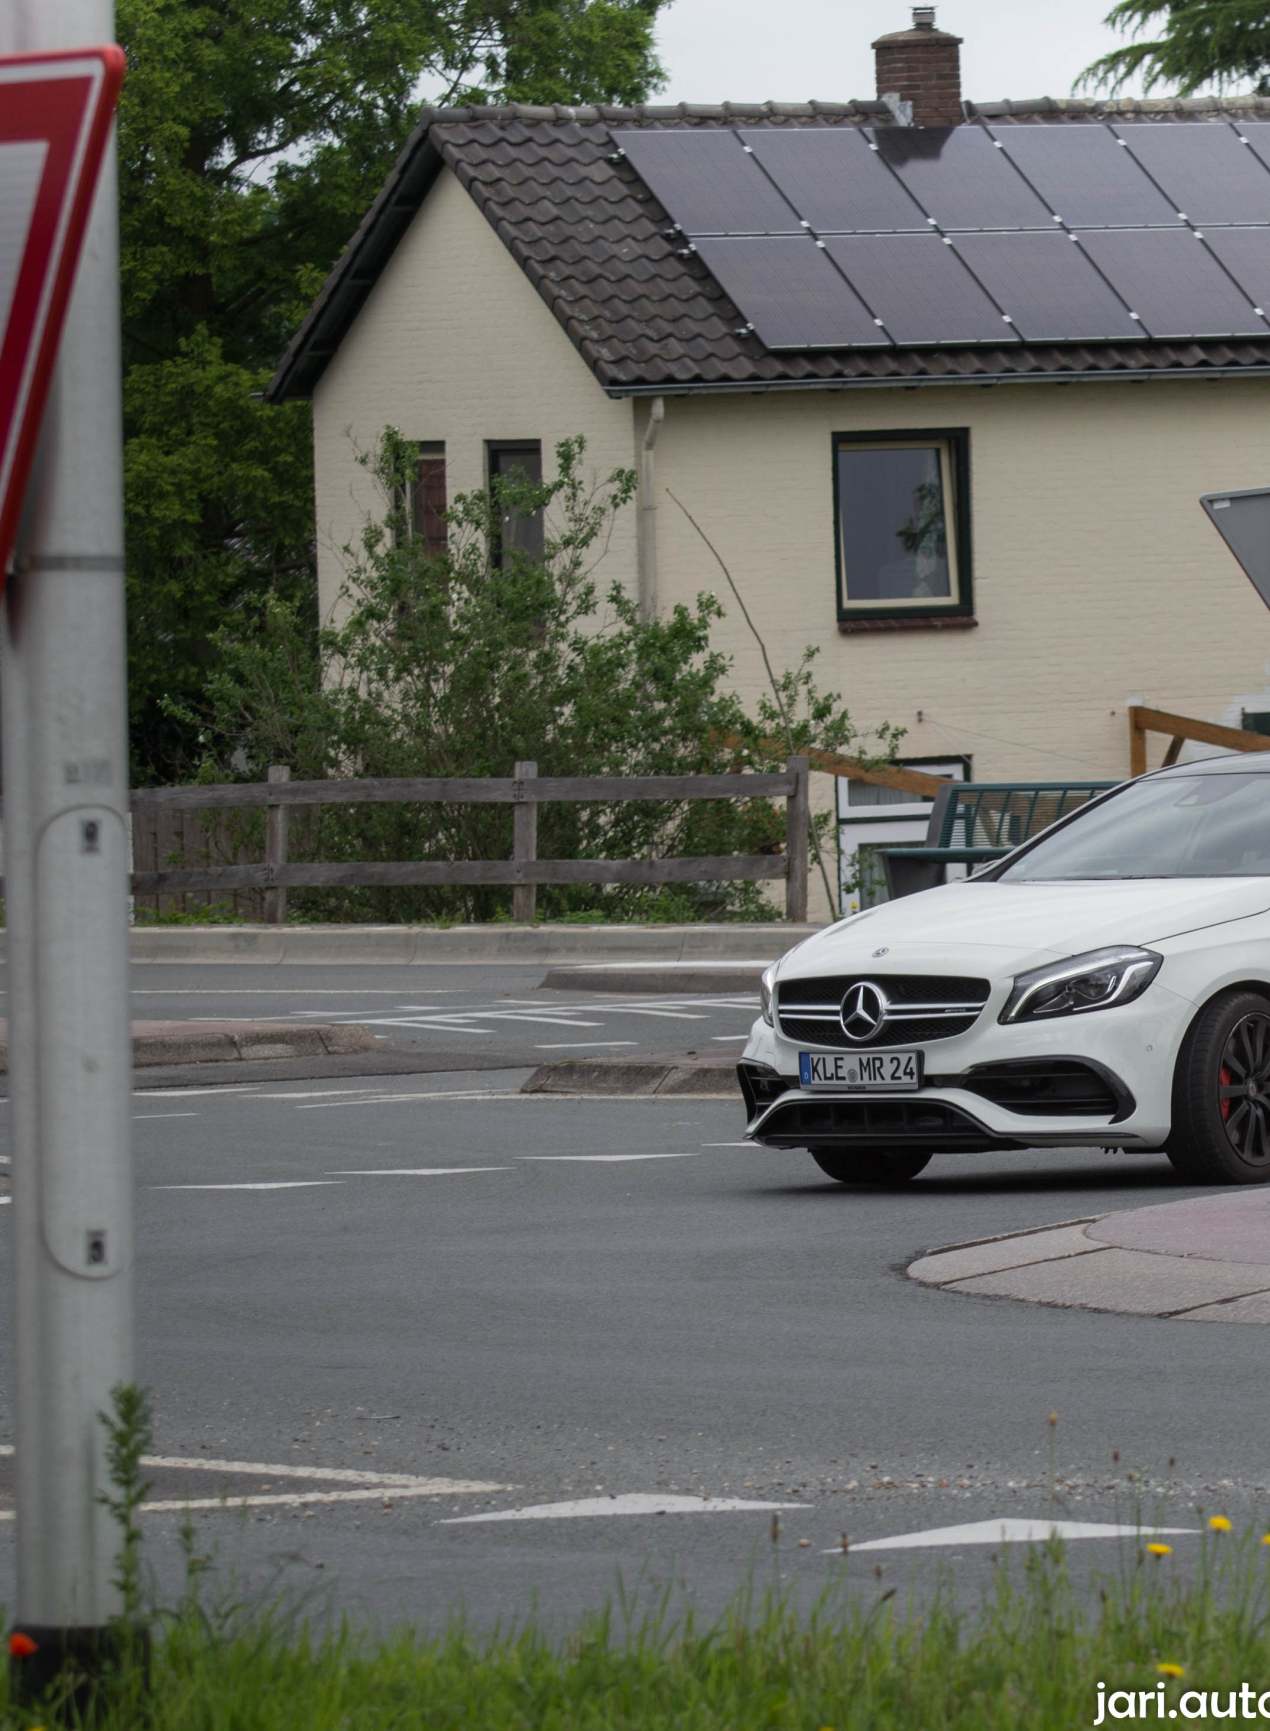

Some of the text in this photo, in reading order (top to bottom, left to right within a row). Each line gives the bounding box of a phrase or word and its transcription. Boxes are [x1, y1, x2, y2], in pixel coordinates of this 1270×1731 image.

[810, 1055, 916, 1082] KLE MR 24
